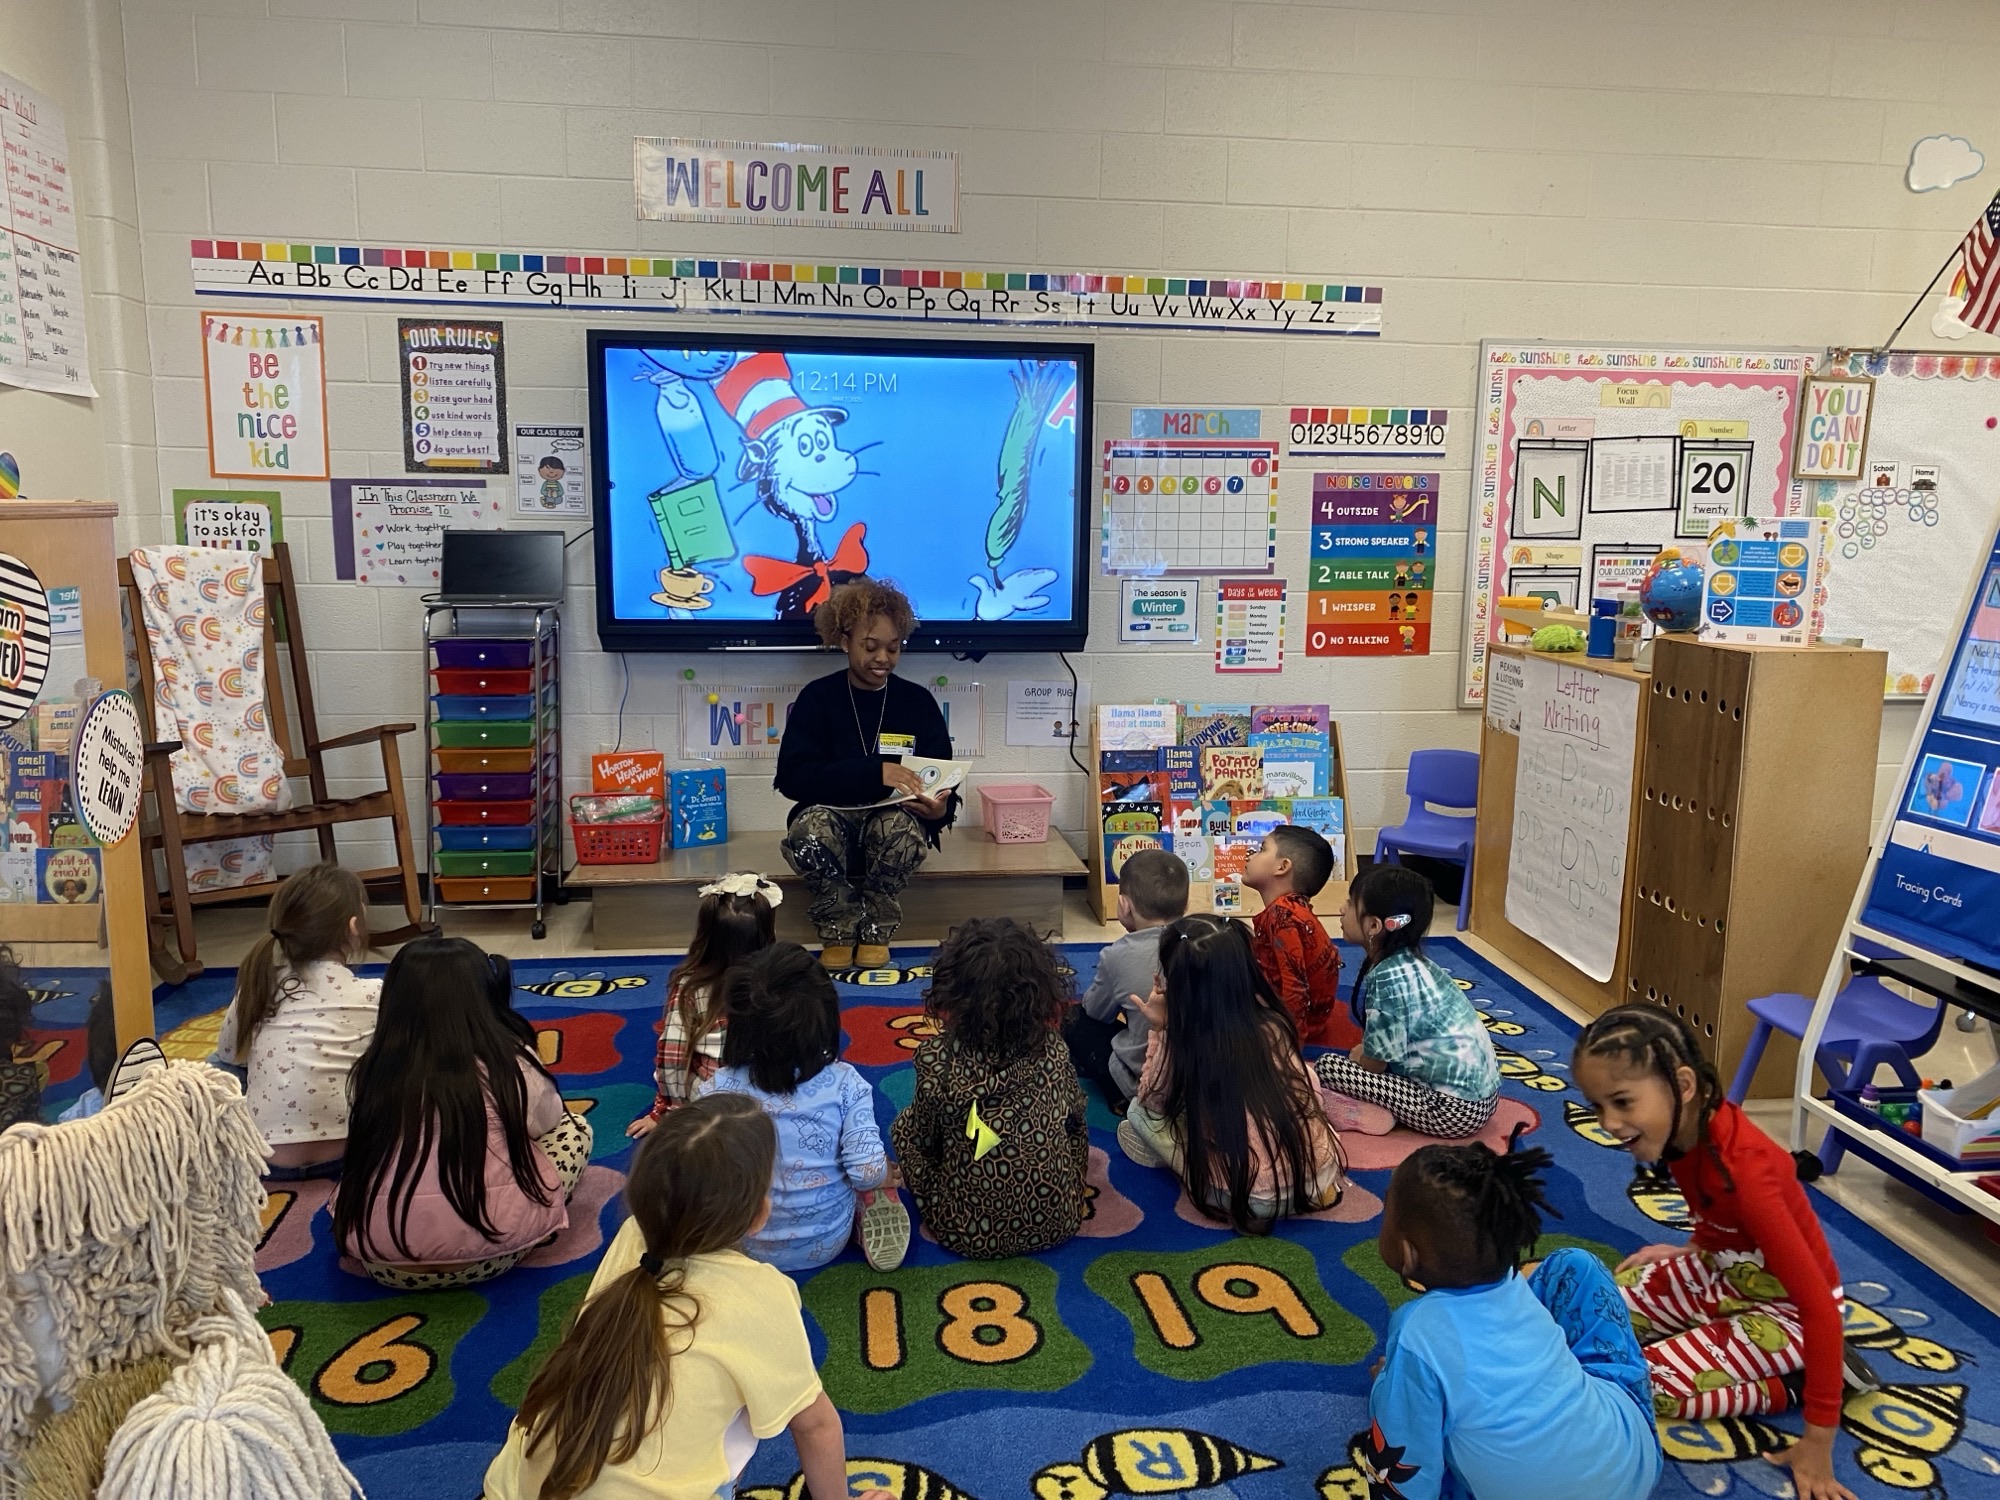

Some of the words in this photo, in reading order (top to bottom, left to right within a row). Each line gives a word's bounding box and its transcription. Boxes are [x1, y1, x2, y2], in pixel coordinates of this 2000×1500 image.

[13, 92, 36, 122] Wall
[666, 157, 849, 213] WELCOME
[862, 169, 929, 216] ALL
[248, 261, 284, 285] Aa
[298, 263, 330, 287] Bb
[344, 266, 378, 290] Cc
[390, 267, 422, 292] Dd
[438, 269, 467, 293] Ee
[484, 271, 513, 294] Ff
[527, 273, 562, 306] Gg
[569, 274, 601, 298] Hh
[622, 276, 636, 299] Ii
[662, 278, 686, 310] Jj
[705, 279, 734, 302] Kk
[740, 280, 760, 303] Ll
[774, 282, 815, 305] Mm
[822, 284, 852, 307] Nn
[864, 286, 897, 308] Oo
[908, 288, 936, 318] Pp
[948, 289, 980, 320] Qq
[992, 290, 1019, 314] Rr
[1034, 292, 1061, 314] Ss
[1071, 292, 1095, 315] Tt
[1111, 294, 1139, 316] Uu
[1152, 296, 1178, 318] Vv
[1189, 297, 1224, 319] Ww
[1227, 298, 1256, 320] Xx
[1269, 300, 1295, 331] Yy
[1309, 301, 1335, 323] Zz
[409, 328, 441, 348] OUR
[446, 328, 493, 350] RULES
[249, 353, 279, 378] Be
[1490, 352, 1516, 363] hello
[1520, 352, 1570, 364] sunshine
[1578, 354, 1603, 365] hello
[429, 361, 443, 372] try
[465, 361, 490, 372] things
[429, 377, 452, 385] listen
[456, 378, 492, 390] carefully
[796, 372, 856, 392] 12:14
[864, 373, 897, 392] PM
[242, 382, 289, 409] the
[1617, 387, 1638, 395] Focus
[430, 395, 450, 403] raise
[452, 396, 472, 406] your
[474, 395, 493, 403] hand
[1814, 388, 1862, 416] YOU
[447, 411, 463, 420] kind
[465, 412, 492, 420] words
[238, 412, 297, 439] nice
[1163, 412, 1230, 435] March
[1810, 416, 1861, 442] CAN
[433, 428, 449, 438] help
[451, 428, 472, 436] clean
[473, 430, 482, 439] up
[520, 428, 535, 436] OUR
[249, 442, 289, 469] kid
[434, 445, 443, 453] do
[445, 447, 465, 455] your
[467, 445, 490, 454] best!
[1807, 443, 1835, 469] DO
[1839, 444, 1859, 470] IT
[1691, 462, 1735, 493] 20
[359, 487, 379, 502] In
[381, 488, 403, 502] This
[406, 490, 457, 502] Classroom
[460, 491, 477, 502] We
[1533, 475, 1565, 519] N
[195, 508, 219, 521] it's
[224, 506, 260, 527] okay
[389, 505, 432, 515] Promise
[435, 504, 450, 515] To
[1321, 502, 1334, 519] 4
[1337, 507, 1378, 515] OUTSIDE
[1693, 504, 1728, 515] twenty
[193, 525, 209, 536] to
[214, 522, 238, 536] ask
[242, 524, 265, 536] for
[386, 524, 412, 533] Work
[387, 542, 406, 553] Play
[1320, 532, 1332, 550] 3
[1335, 538, 1369, 546] STRONG
[1371, 537, 1409, 545] SPEAKER
[1546, 552, 1564, 560] Shape
[1318, 566, 1331, 582] 2
[1334, 571, 1363, 579] TABLE
[1366, 571, 1389, 579] TALK
[1599, 568, 1612, 576] OUR
[1134, 589, 1148, 597] The
[1180, 589, 1186, 597] is
[1141, 602, 1177, 612] Winter
[1319, 598, 1327, 615] 1
[1332, 603, 1376, 611] WHISPER
[1312, 632, 1326, 649] 0
[1330, 636, 1344, 644] NO
[1347, 636, 1390, 644] TALKING
[1972, 645, 1990, 657] Nick
[1500, 661, 1521, 675] READING
[1966, 662, 1978, 674] He
[1500, 674, 1523, 688] LISTENING
[1557, 664, 1599, 704] Letter
[1025, 688, 1052, 696] GROUP
[1057, 688, 1073, 696] RUG
[1112, 709, 1135, 717] llama
[1138, 709, 1162, 717] llama
[1108, 720, 1126, 728] mad
[1139, 720, 1166, 728] mama
[1544, 700, 1600, 751] Writing
[102, 726, 135, 767] Mistakes
[1167, 750, 1192, 758] llama
[99, 748, 117, 777] help
[119, 772, 130, 788] me
[1167, 760, 1193, 768] llama
[1212, 754, 1257, 767] POTATO
[598, 758, 634, 779] HORTON
[616, 764, 642, 784] HEARS
[636, 761, 662, 783] WHO!
[1172, 769, 1188, 778] red
[1214, 768, 1255, 779] PANTS!
[1266, 771, 1307, 785] maravilloso
[98, 777, 124, 816] LEARN
[1896, 874, 1930, 903] Tracing
[1933, 886, 1963, 908] Cards
[859, 1280, 1044, 1371] 18
[1130, 1263, 1325, 1350] 19
[1129, 1440, 1183, 1480] R
